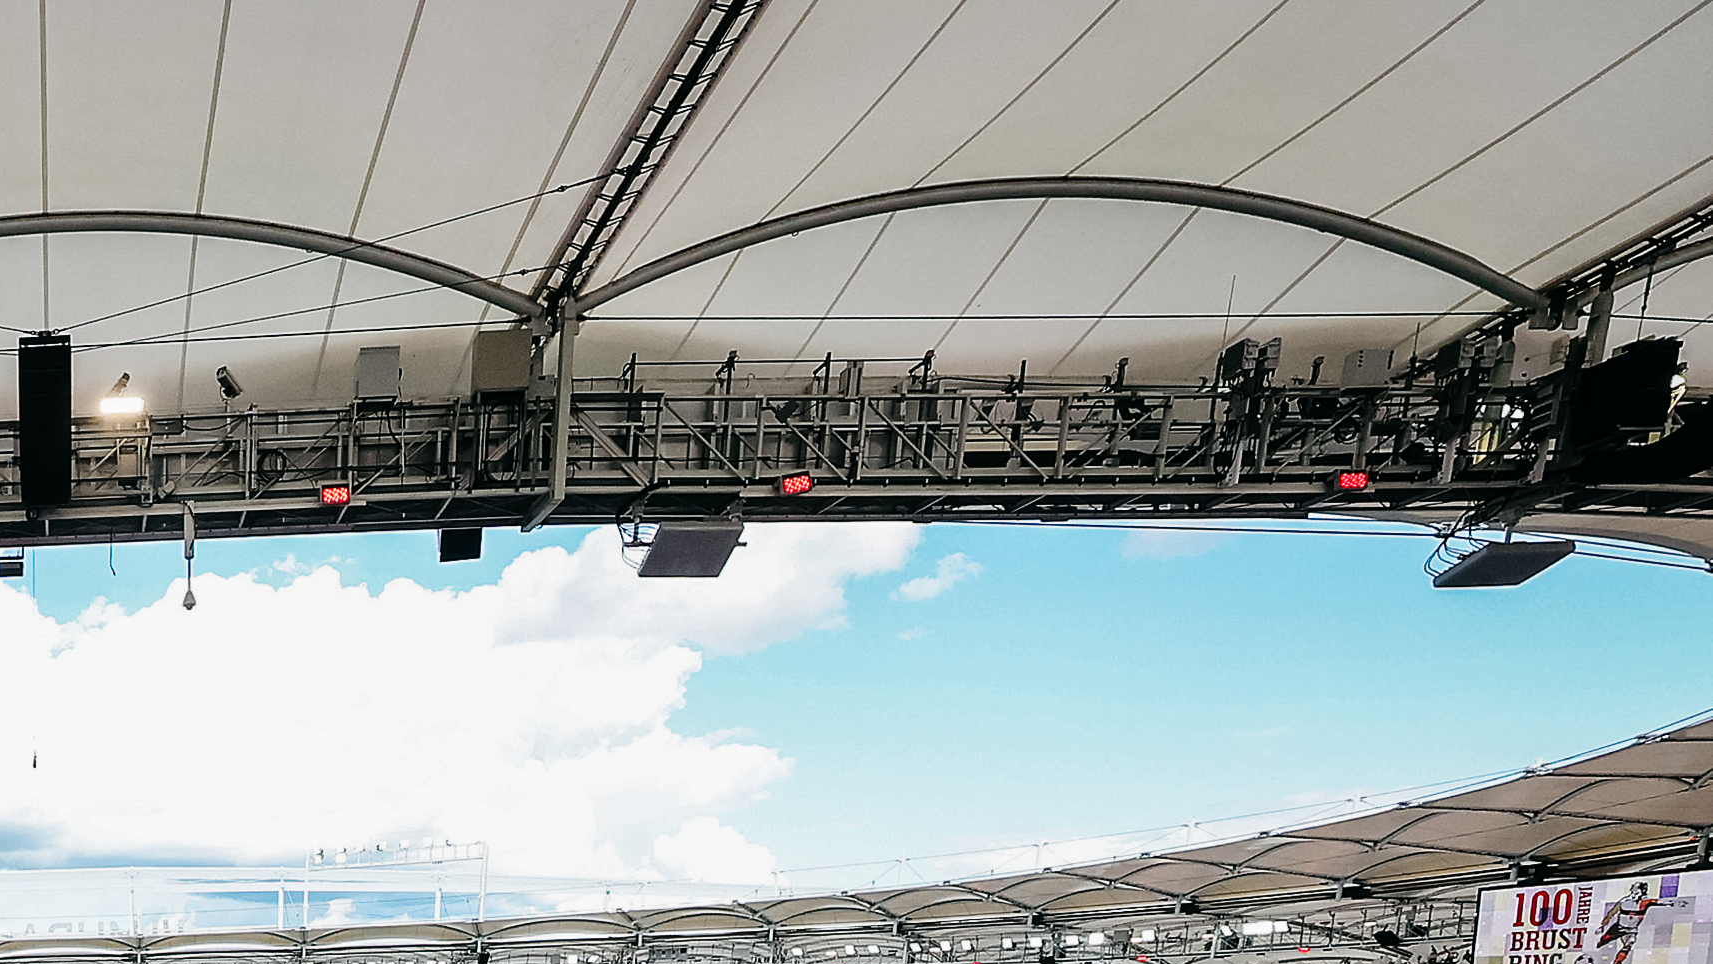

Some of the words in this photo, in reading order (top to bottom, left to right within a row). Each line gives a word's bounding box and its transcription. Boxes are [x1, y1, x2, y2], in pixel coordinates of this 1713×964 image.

[1513, 889, 1573, 927] 100
[1576, 886, 1593, 925] JAHRE
[1510, 927, 1587, 951] BRUST
